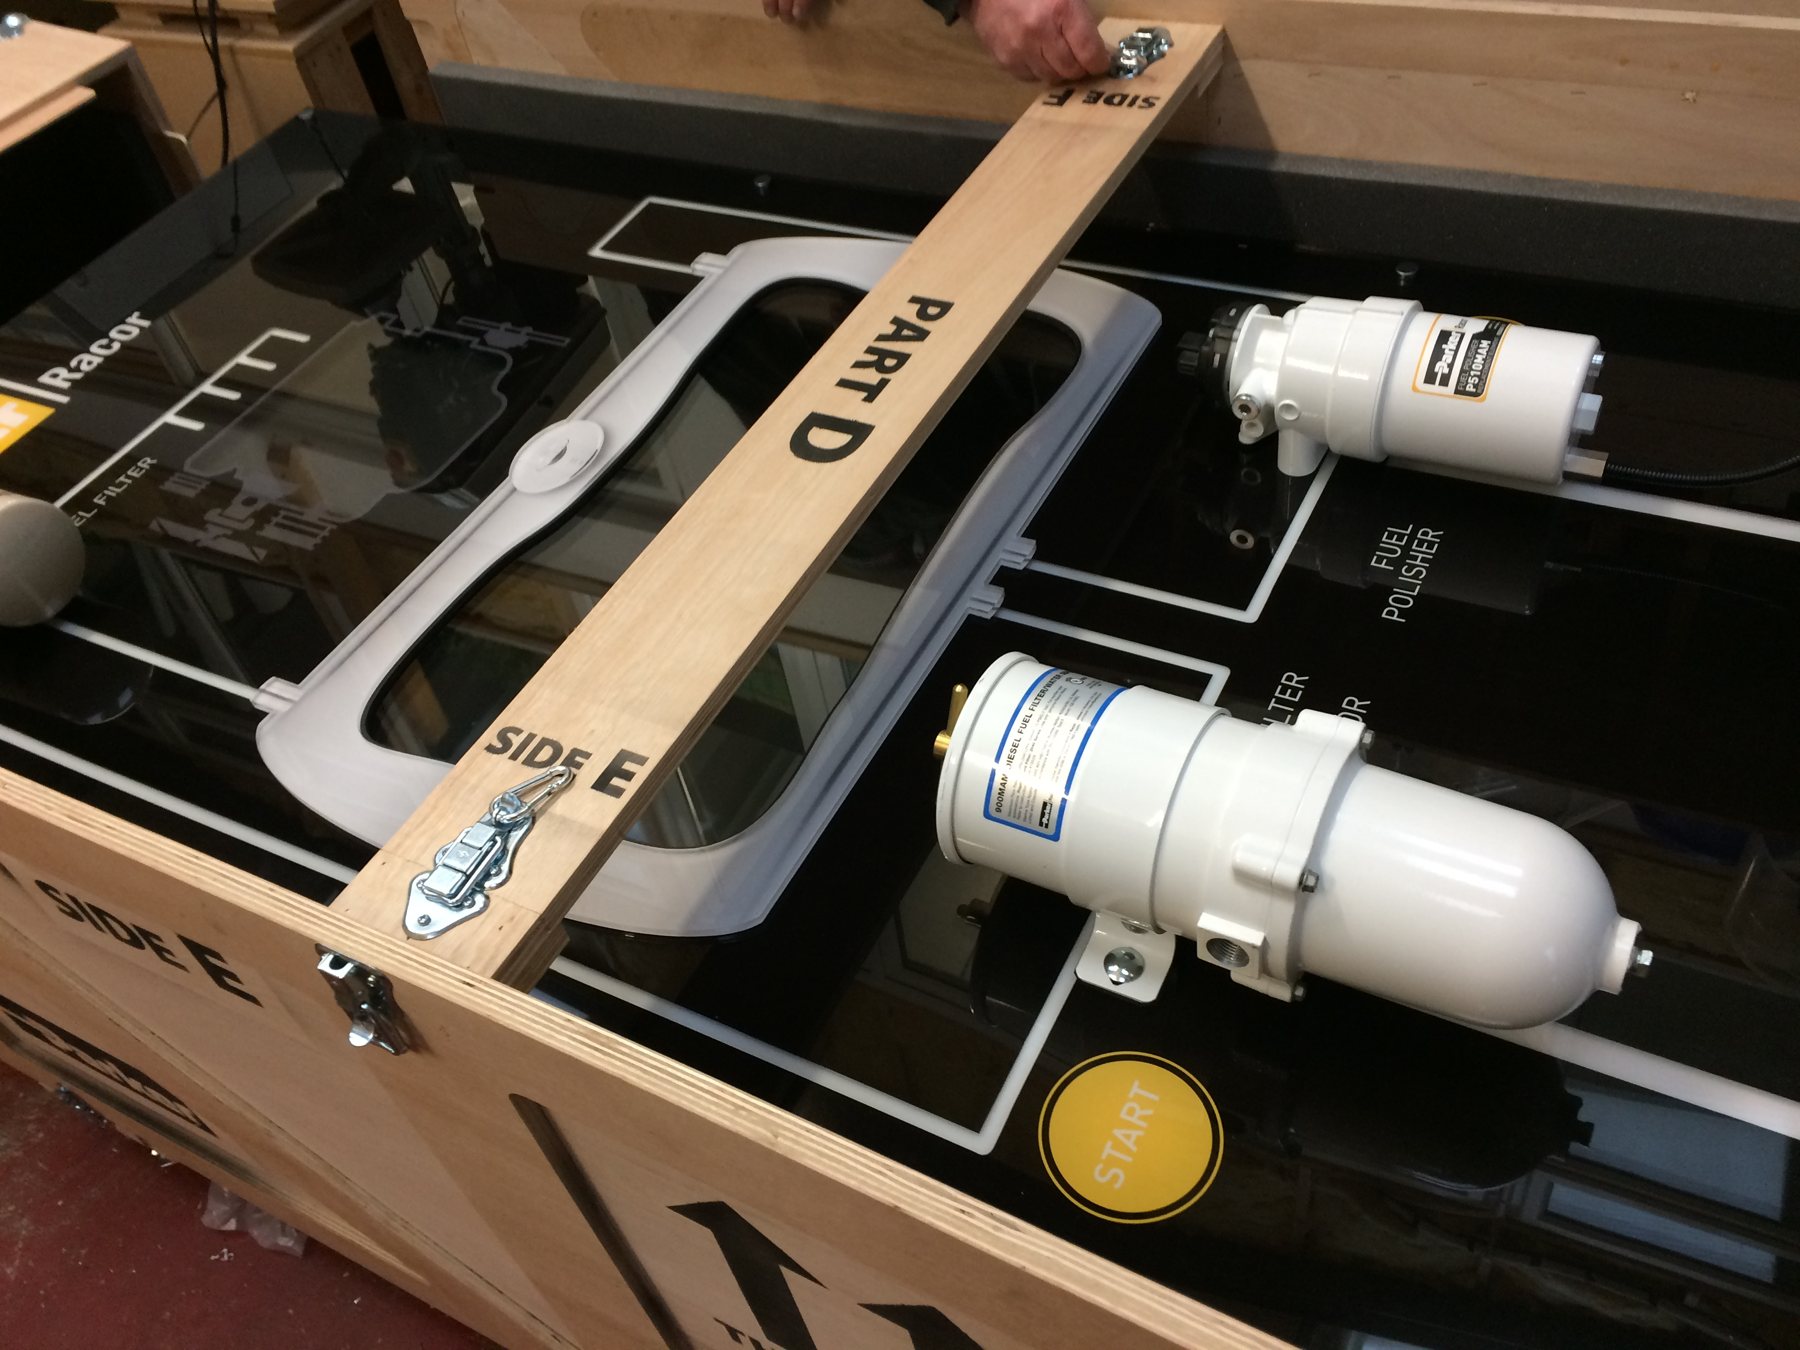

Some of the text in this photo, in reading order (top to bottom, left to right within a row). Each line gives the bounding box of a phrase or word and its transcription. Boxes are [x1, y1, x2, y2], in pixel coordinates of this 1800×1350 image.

[1042, 88, 1161, 109] SIDE F
[37, 311, 152, 389] Racor
[789, 295, 955, 464] PART D
[1434, 331, 1462, 374] Parker
[1465, 339, 1492, 393] P510MAM
[71, 456, 157, 527] EL FILTER
[1370, 524, 1413, 570] FUEL
[1381, 527, 1444, 622] POLISHER
[1261, 671, 1310, 727] LTER
[484, 726, 650, 799] SIDE E
[1006, 736, 1022, 769] IESEL
[1017, 713, 1033, 735] FUEL
[34, 879, 264, 1008] SIDE E
[1093, 1079, 1160, 1189] START
